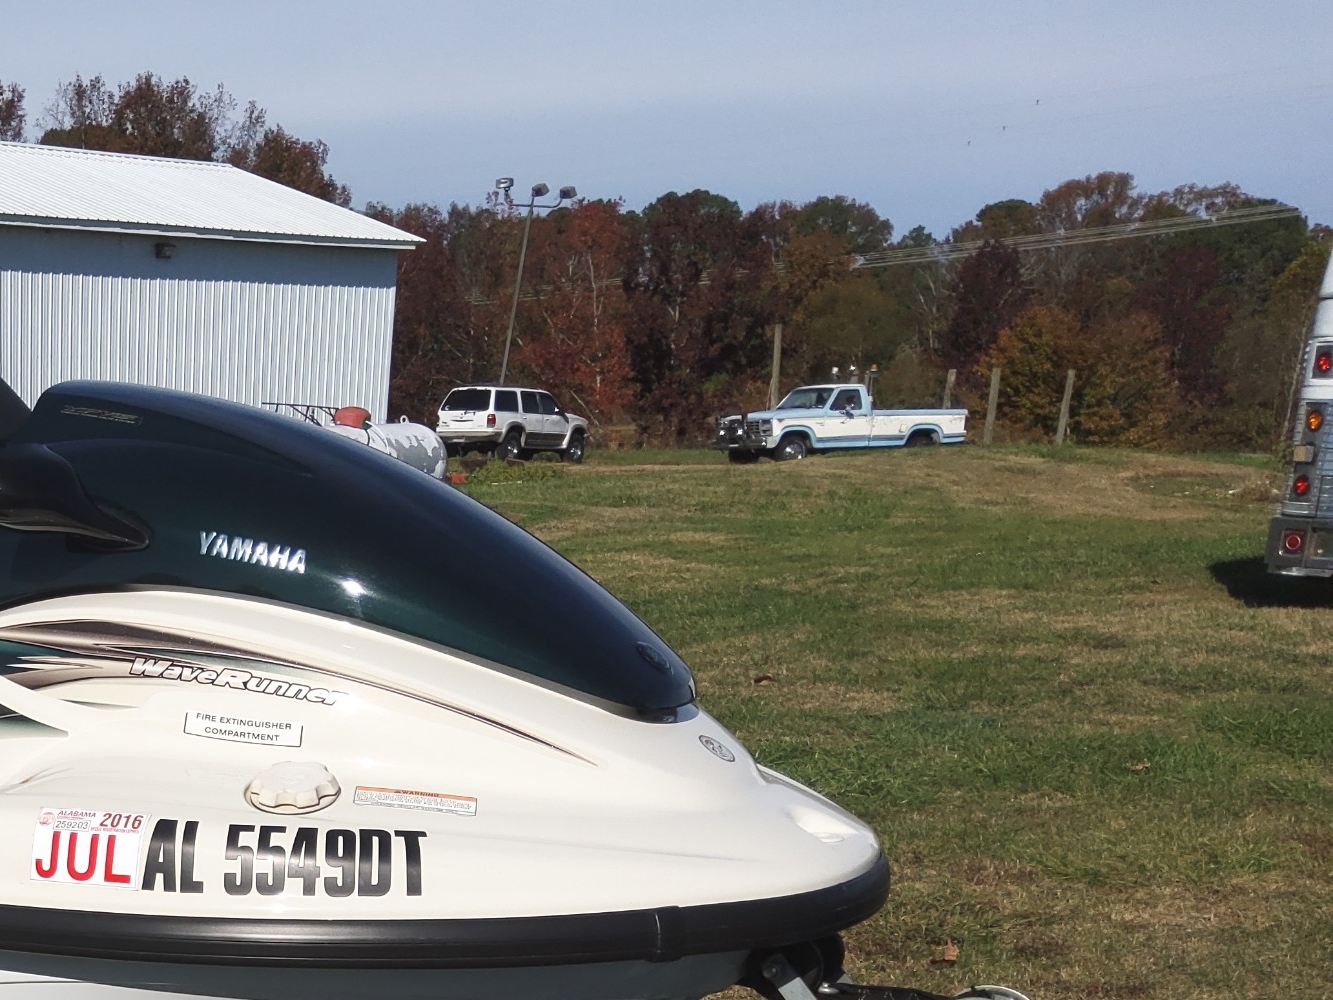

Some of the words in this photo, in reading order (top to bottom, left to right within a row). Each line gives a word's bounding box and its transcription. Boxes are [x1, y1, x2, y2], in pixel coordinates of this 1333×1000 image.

[200, 531, 306, 574] YAMAHA
[129, 656, 350, 706] WaveRunner
[196, 712, 217, 723] FIRE
[219, 716, 292, 731] EXTINGUISHER
[204, 726, 280, 742] COMPARTMENT
[57, 810, 97, 818] ALABAMA
[99, 812, 144, 830] 2016
[55, 820, 89, 830] 259203
[35, 831, 131, 884] JUL
[141, 818, 204, 894] AL
[224, 824, 427, 898] 5549DT
